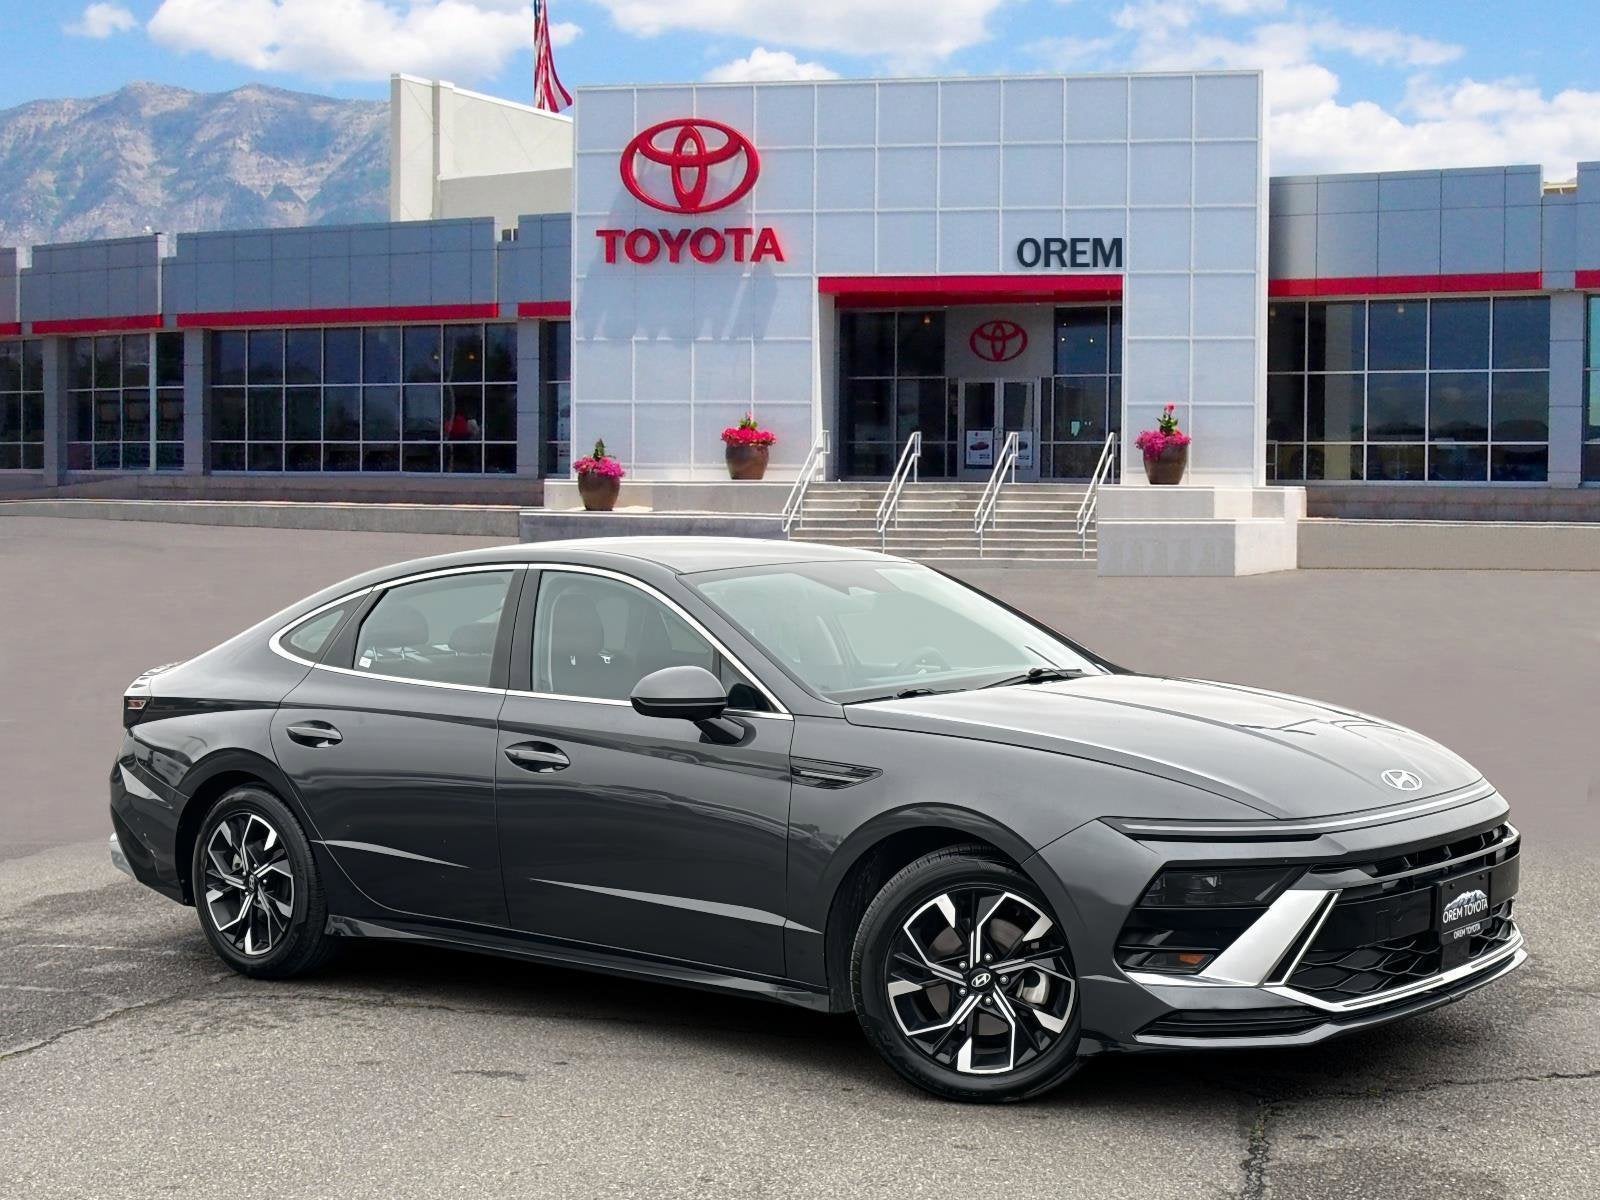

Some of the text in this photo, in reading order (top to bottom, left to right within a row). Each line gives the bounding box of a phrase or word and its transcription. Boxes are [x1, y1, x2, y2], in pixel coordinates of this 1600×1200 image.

[596, 227, 785, 264] TOYOTA
[1016, 237, 1123, 268] OREM
[1443, 898, 1488, 923] OREM TOYOTA
[1453, 923, 1480, 939] OREM TOYOTA
